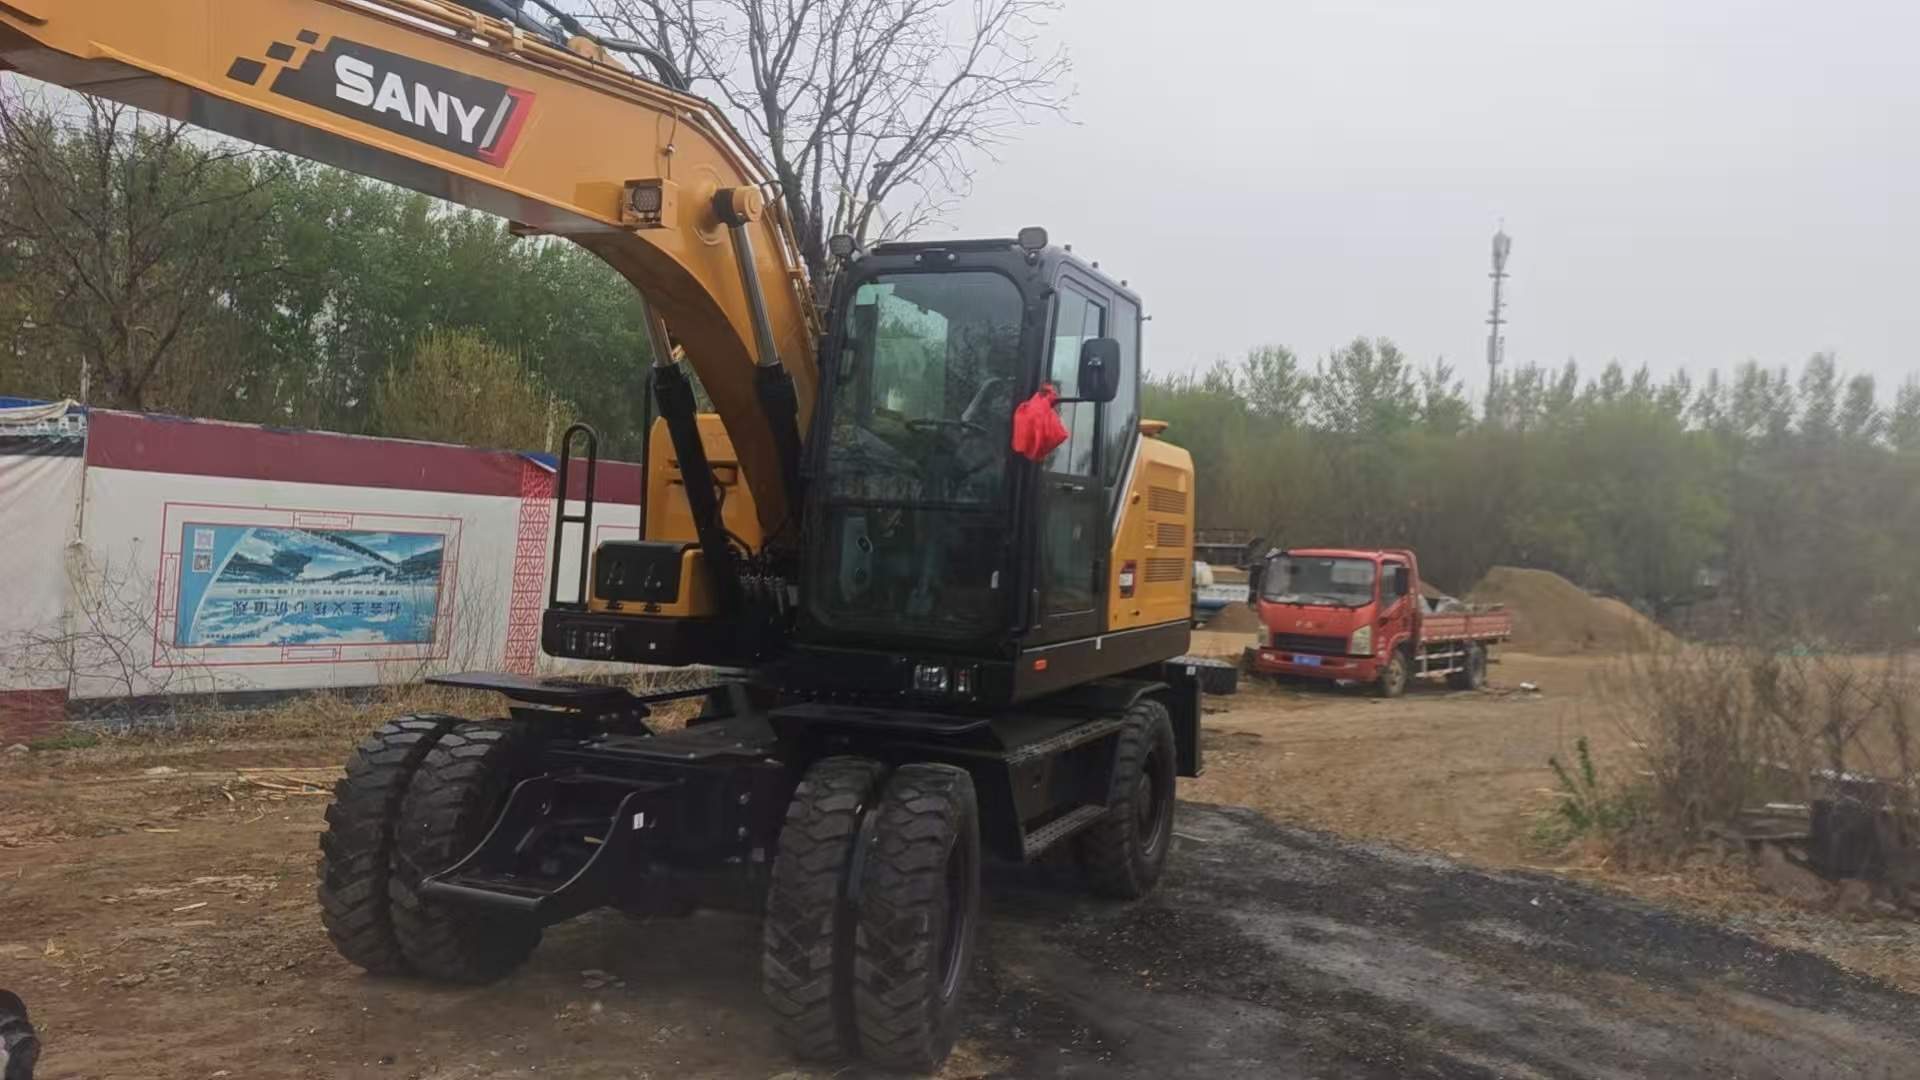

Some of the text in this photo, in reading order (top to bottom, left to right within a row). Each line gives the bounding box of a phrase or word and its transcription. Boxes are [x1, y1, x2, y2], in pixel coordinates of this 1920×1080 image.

[334, 54, 485, 144] SANY
[232, 599, 402, 617] 社会主义核心价值观
